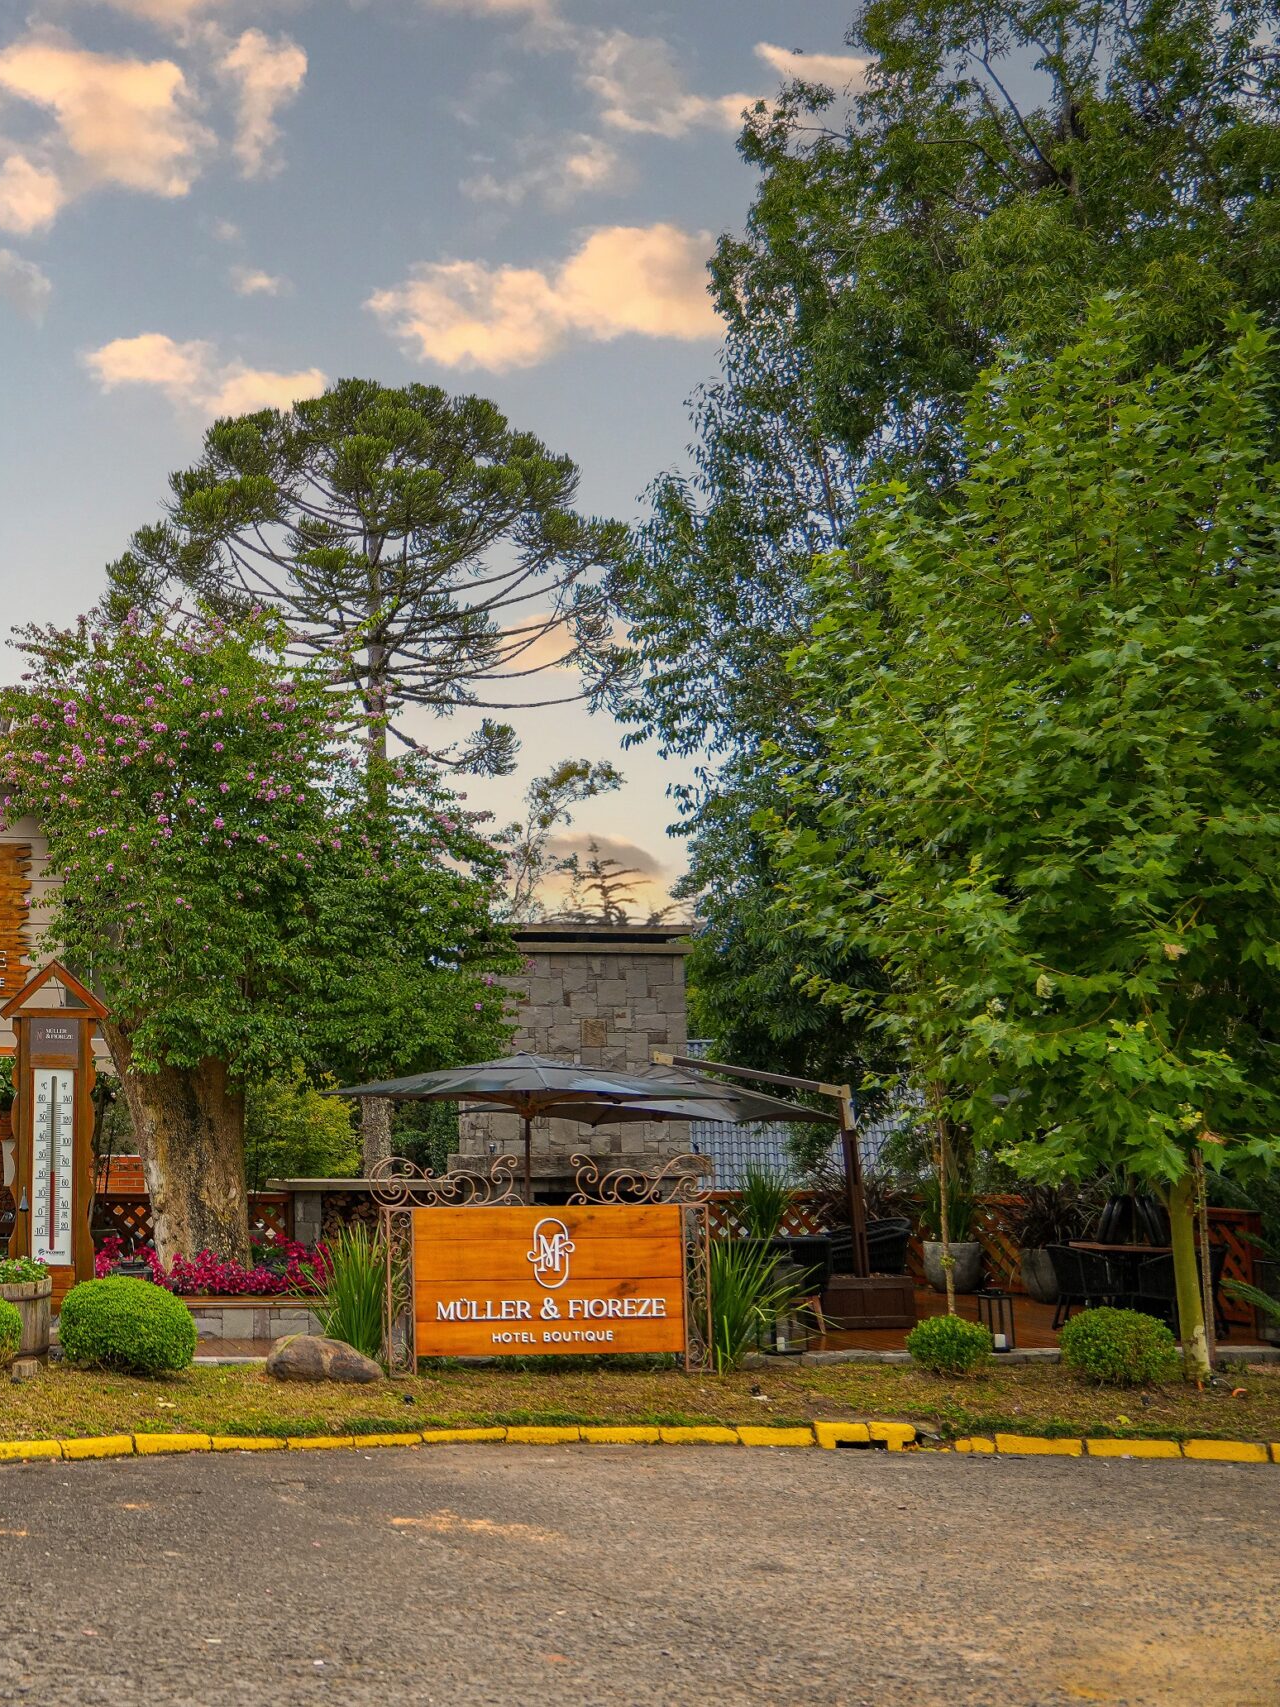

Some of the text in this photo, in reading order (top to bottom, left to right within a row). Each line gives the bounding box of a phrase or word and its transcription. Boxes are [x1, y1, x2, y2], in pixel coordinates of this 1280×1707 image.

[38, 1094, 46, 1102] 60
[63, 1095, 72, 1103] 140
[62, 1137, 72, 1145] 100
[38, 1170, 46, 1178] 20
[61, 1179, 69, 1187] 60
[38, 1189, 46, 1197] 10
[61, 1200, 69, 1208] 40
[37, 1208, 43, 1216] 0
[60, 1222, 69, 1230] 20
[436, 1297, 667, 1321] MÜLLER & FIOREZE
[492, 1330, 614, 1343] HOTEL BOUTIQUE
